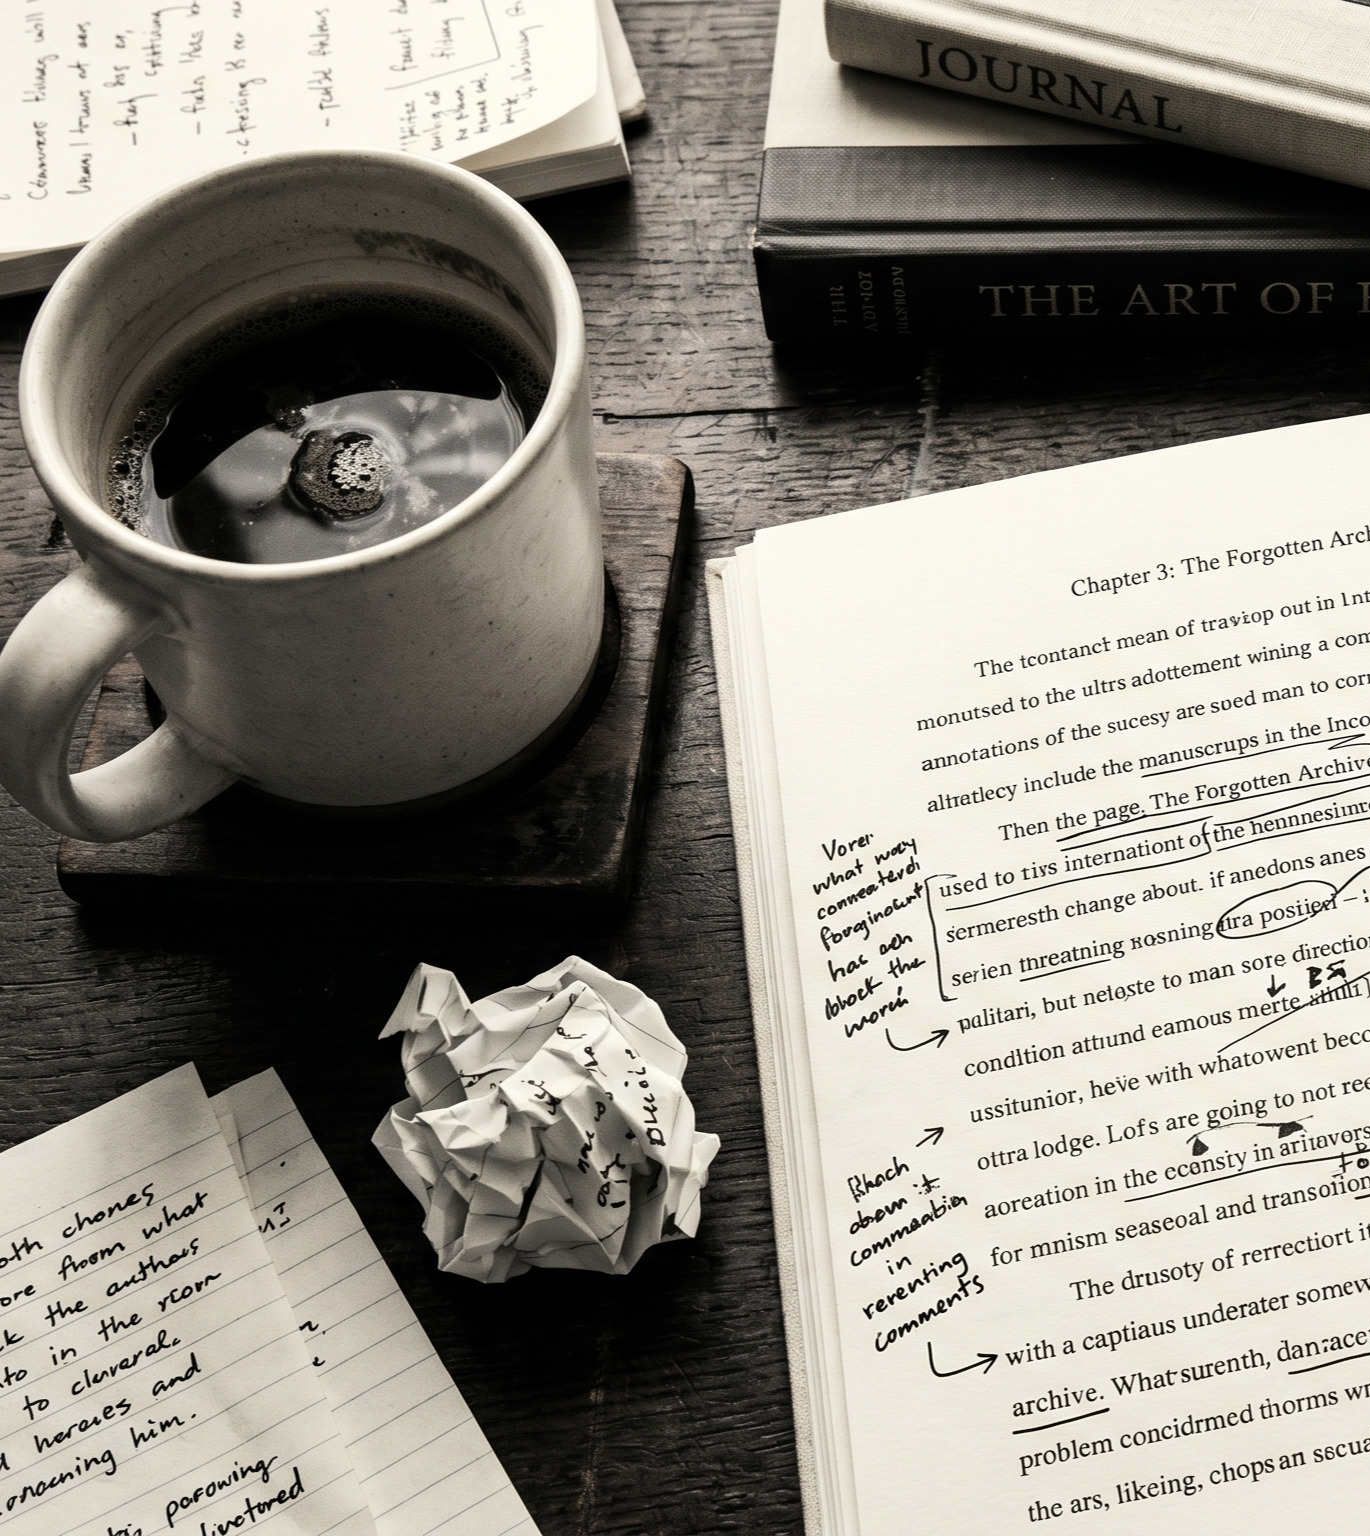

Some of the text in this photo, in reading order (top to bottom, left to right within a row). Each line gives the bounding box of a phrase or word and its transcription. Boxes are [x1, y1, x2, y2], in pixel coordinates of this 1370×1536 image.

[915, 39, 1183, 133] JOURNAL
[978, 283, 1100, 318] THE
[1120, 283, 1238, 318] ART
[1257, 281, 1335, 317] OF
[1071, 571, 1150, 596] Chapter
[1156, 564, 1174, 580] 3:
[1181, 556, 1220, 575] The
[1226, 539, 1324, 567] Forgotten
[974, 590, 1335, 677] The mean out in
[917, 697, 1015, 731] monutsed
[1046, 688, 1075, 704] the
[1082, 679, 1126, 697] ultrs
[1132, 654, 1242, 687] adottement
[922, 738, 1039, 771] annotations
[1071, 724, 1101, 740] the
[1107, 711, 1170, 733] sucesy
[1176, 705, 1205, 720] are
[1024, 759, 1133, 793] include the
[998, 822, 1049, 841] Then
[1149, 792, 1190, 809] The
[1194, 773, 1291, 801] Forgotten
[940, 877, 987, 898] used
[1065, 893, 1136, 917] change
[1042, 995, 1077, 1013] but
[1188, 964, 1235, 984] man
[1152, 1011, 1232, 1038] eamous
[978, 1149, 1029, 1170] ottra
[1033, 1134, 1100, 1159] lodge.
[1206, 1100, 1268, 1129] going
[1095, 1177, 1117, 1195] in
[143, 1193, 208, 1239] what
[1115, 1204, 1209, 1241] seaseoal
[1216, 1194, 1257, 1220] and
[1121, 1262, 1204, 1290] drusoty
[45, 1301, 88, 1327] the
[1083, 1295, 1289, 1352] captiaus underater
[49, 1314, 143, 1366] in the
[152, 1352, 202, 1396] and
[23, 1395, 49, 1420] to
[1013, 1388, 1105, 1418] archive.
[130, 1414, 202, 1448] him.
[1019, 1438, 1114, 1476] problem
[1116, 1475, 1203, 1504] likeing,
